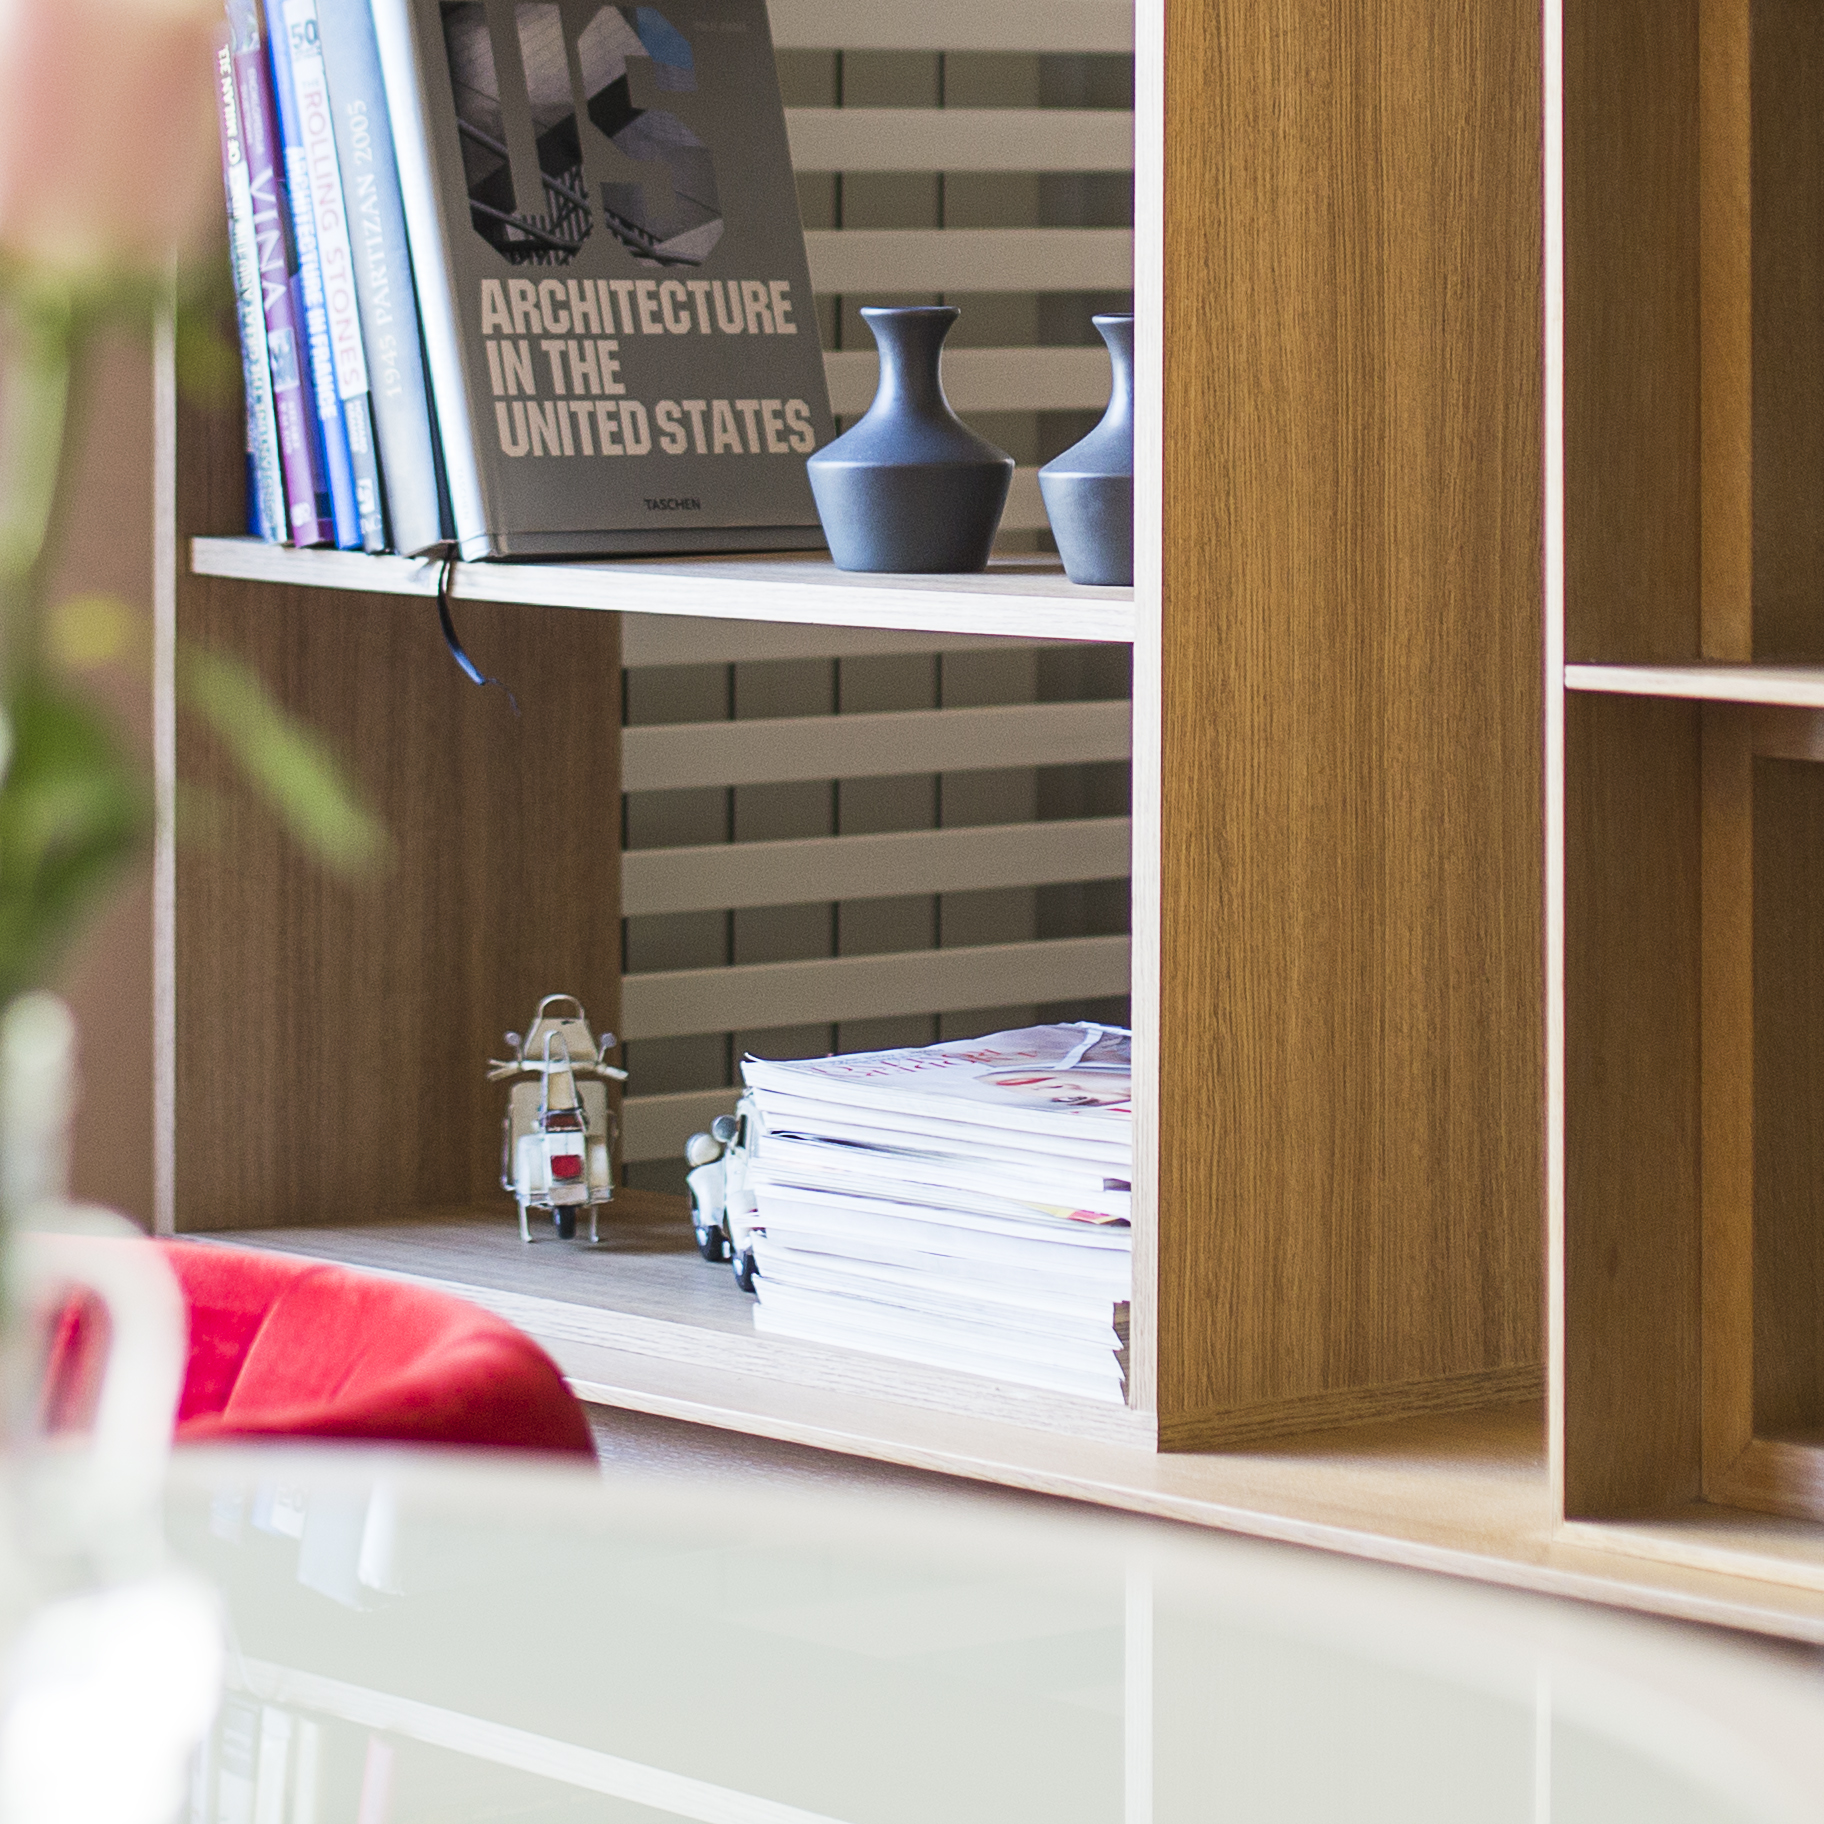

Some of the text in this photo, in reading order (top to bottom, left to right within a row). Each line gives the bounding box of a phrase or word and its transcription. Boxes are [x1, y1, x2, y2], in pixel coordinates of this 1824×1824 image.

[289, 19, 318, 47] 50
[223, 75, 239, 133] MILAN
[227, 138, 241, 165] OF
[438, 1, 725, 268] US
[250, 168, 287, 310] VINA
[305, 90, 339, 232] ROLLING
[326, 247, 360, 387] STONES
[346, 99, 403, 399] 1945 PARTIZAN 2005
[287, 147, 337, 420] ARCHITECTURE IN FRANCE
[479, 277, 798, 336] ARCHITECTURE
[485, 339, 626, 396] IN THE
[493, 399, 816, 458] UNITED STATES
[644, 497, 702, 512] TASCHEN
